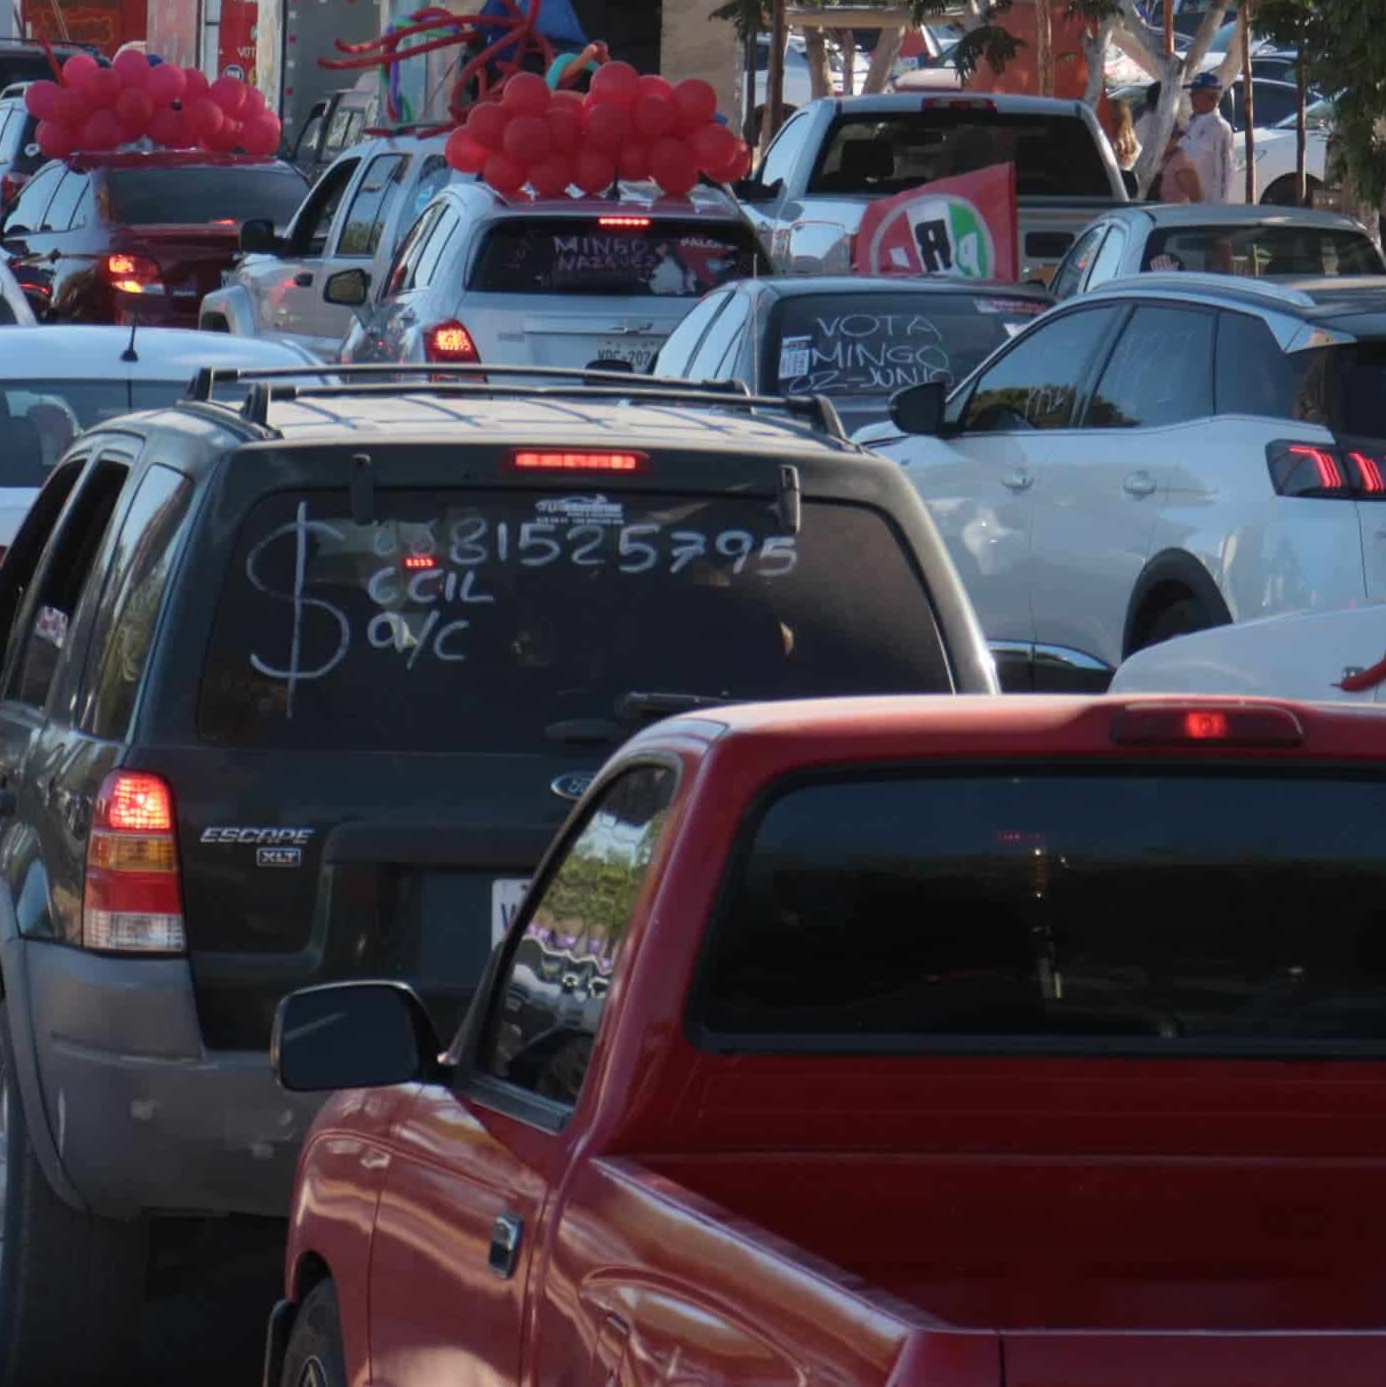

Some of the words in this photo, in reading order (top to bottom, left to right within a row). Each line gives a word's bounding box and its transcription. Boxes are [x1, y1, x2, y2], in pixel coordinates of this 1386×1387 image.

[553, 236, 648, 255] MINGO
[815, 314, 942, 342] VOTA
[812, 341, 949, 368] MINGO
[200, 826, 314, 844] ESCAPE
[262, 851, 297, 863] XLT
